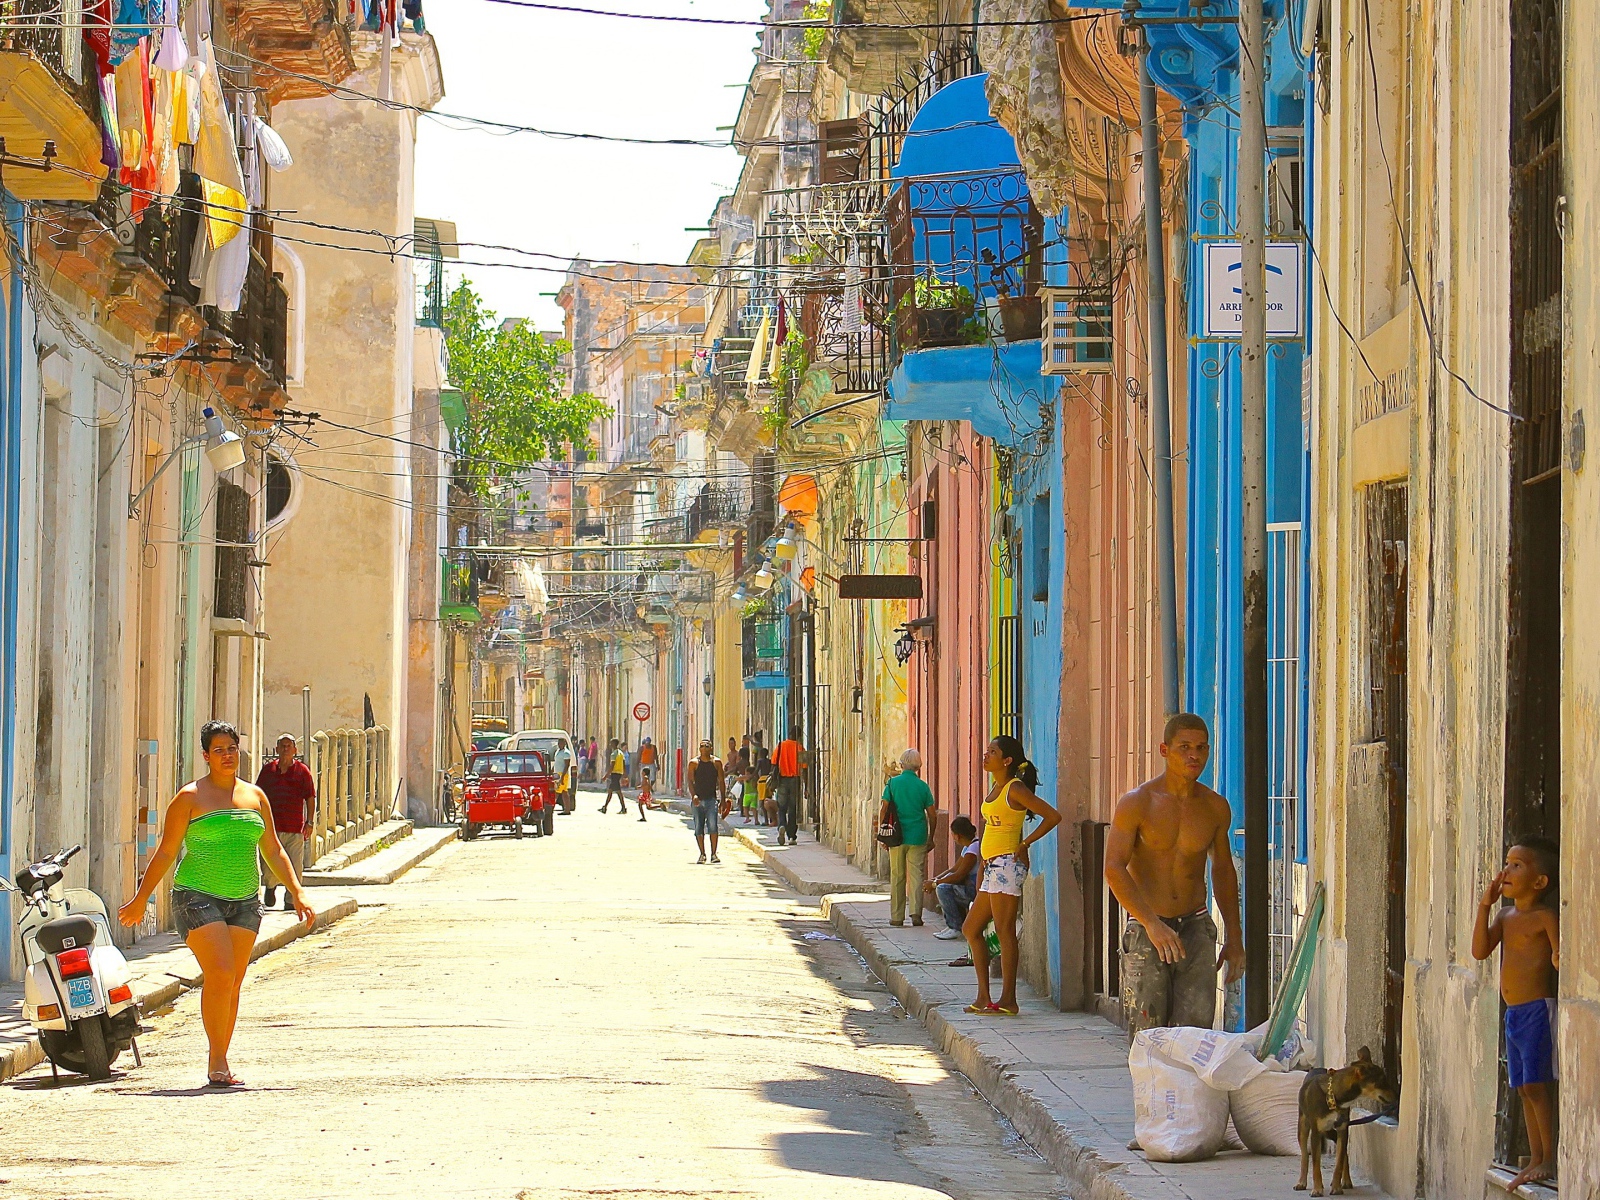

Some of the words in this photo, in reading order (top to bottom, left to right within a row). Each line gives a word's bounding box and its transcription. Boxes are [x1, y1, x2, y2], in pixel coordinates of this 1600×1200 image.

[1219, 302, 1284, 311] ARREDOR
[68, 979, 91, 994] HZB
[71, 992, 94, 1006] 203
